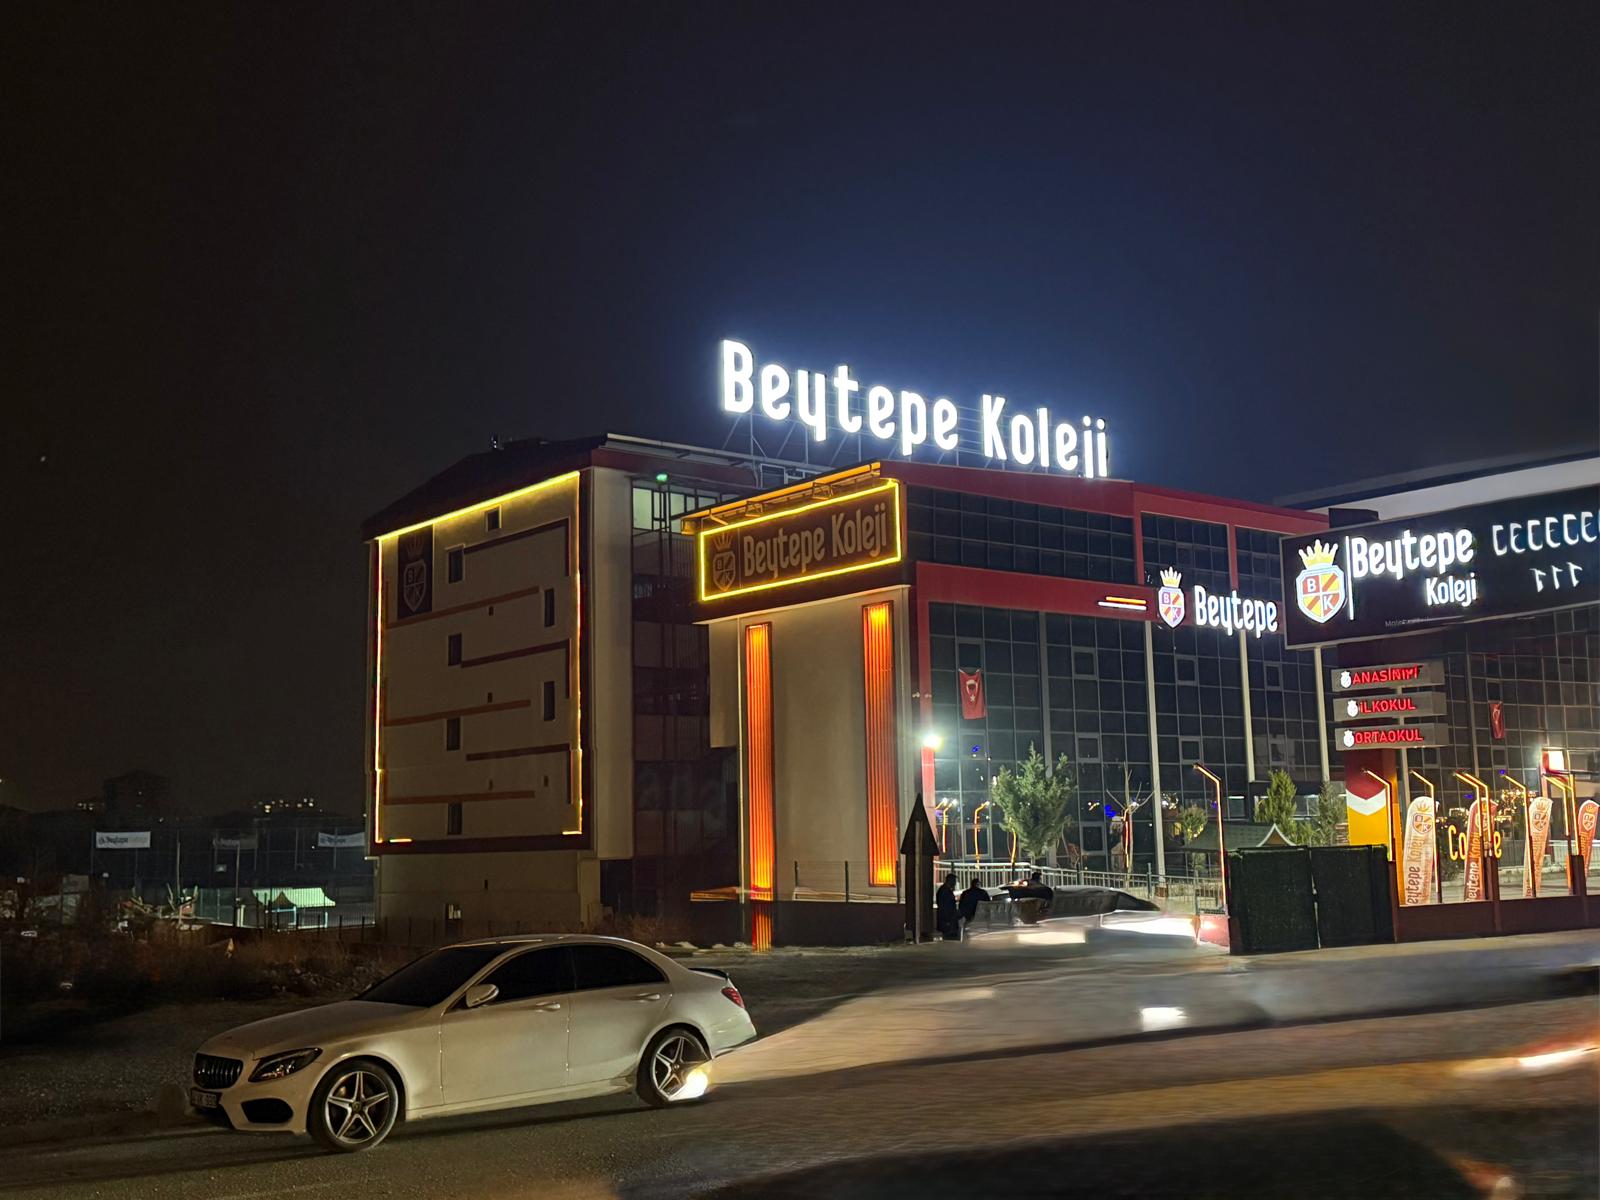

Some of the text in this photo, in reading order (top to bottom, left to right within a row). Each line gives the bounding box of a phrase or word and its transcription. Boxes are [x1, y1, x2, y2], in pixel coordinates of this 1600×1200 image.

[720, 338, 1109, 479] Beytepe Koleji
[743, 502, 887, 579] Beytepe Koleji
[1351, 527, 1475, 580] Beytepe
[1307, 578, 1317, 593] B
[1323, 594, 1333, 610] K
[1426, 571, 1477, 607] Koleji
[1194, 584, 1278, 639] Beytepe
[1355, 729, 1423, 744] ORTAOKUL
[1405, 866, 1422, 904] eytepe
